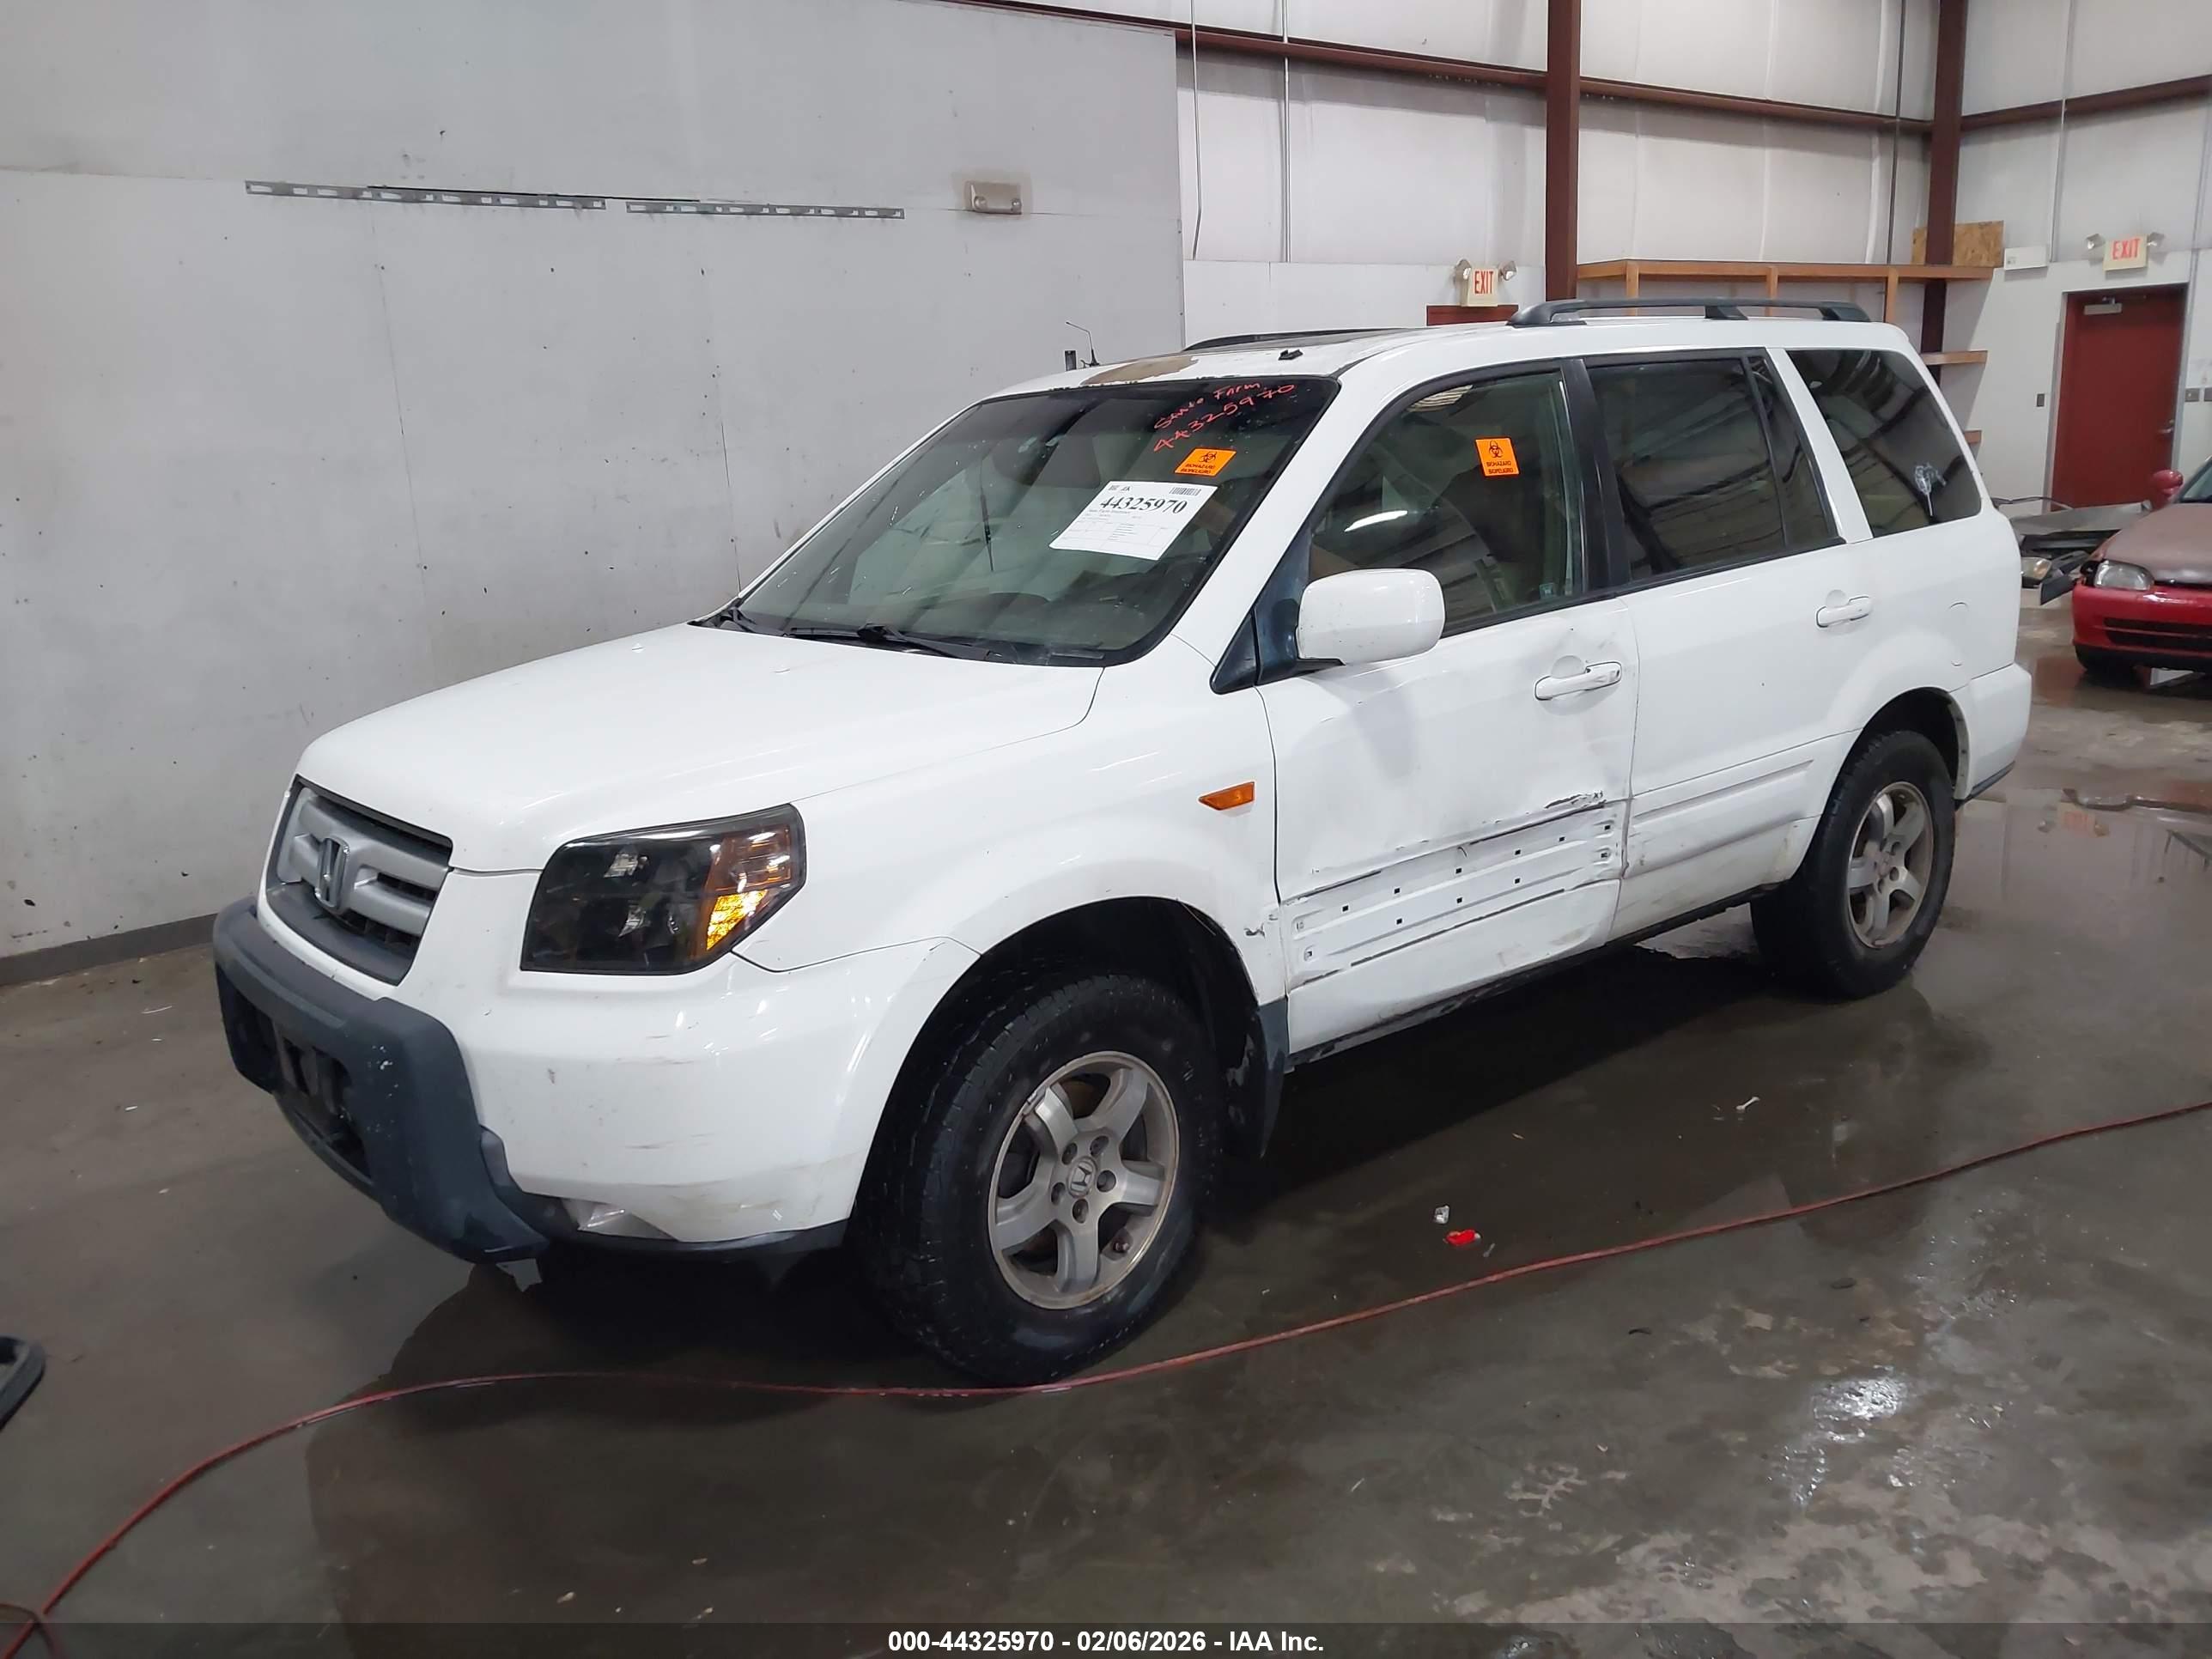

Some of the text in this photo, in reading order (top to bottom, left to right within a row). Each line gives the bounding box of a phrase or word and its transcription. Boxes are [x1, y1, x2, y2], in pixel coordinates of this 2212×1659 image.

[2112, 238, 2141, 260] EXIT
[1474, 270, 1494, 295] EXIT
[1100, 495, 1188, 514] 44325970
